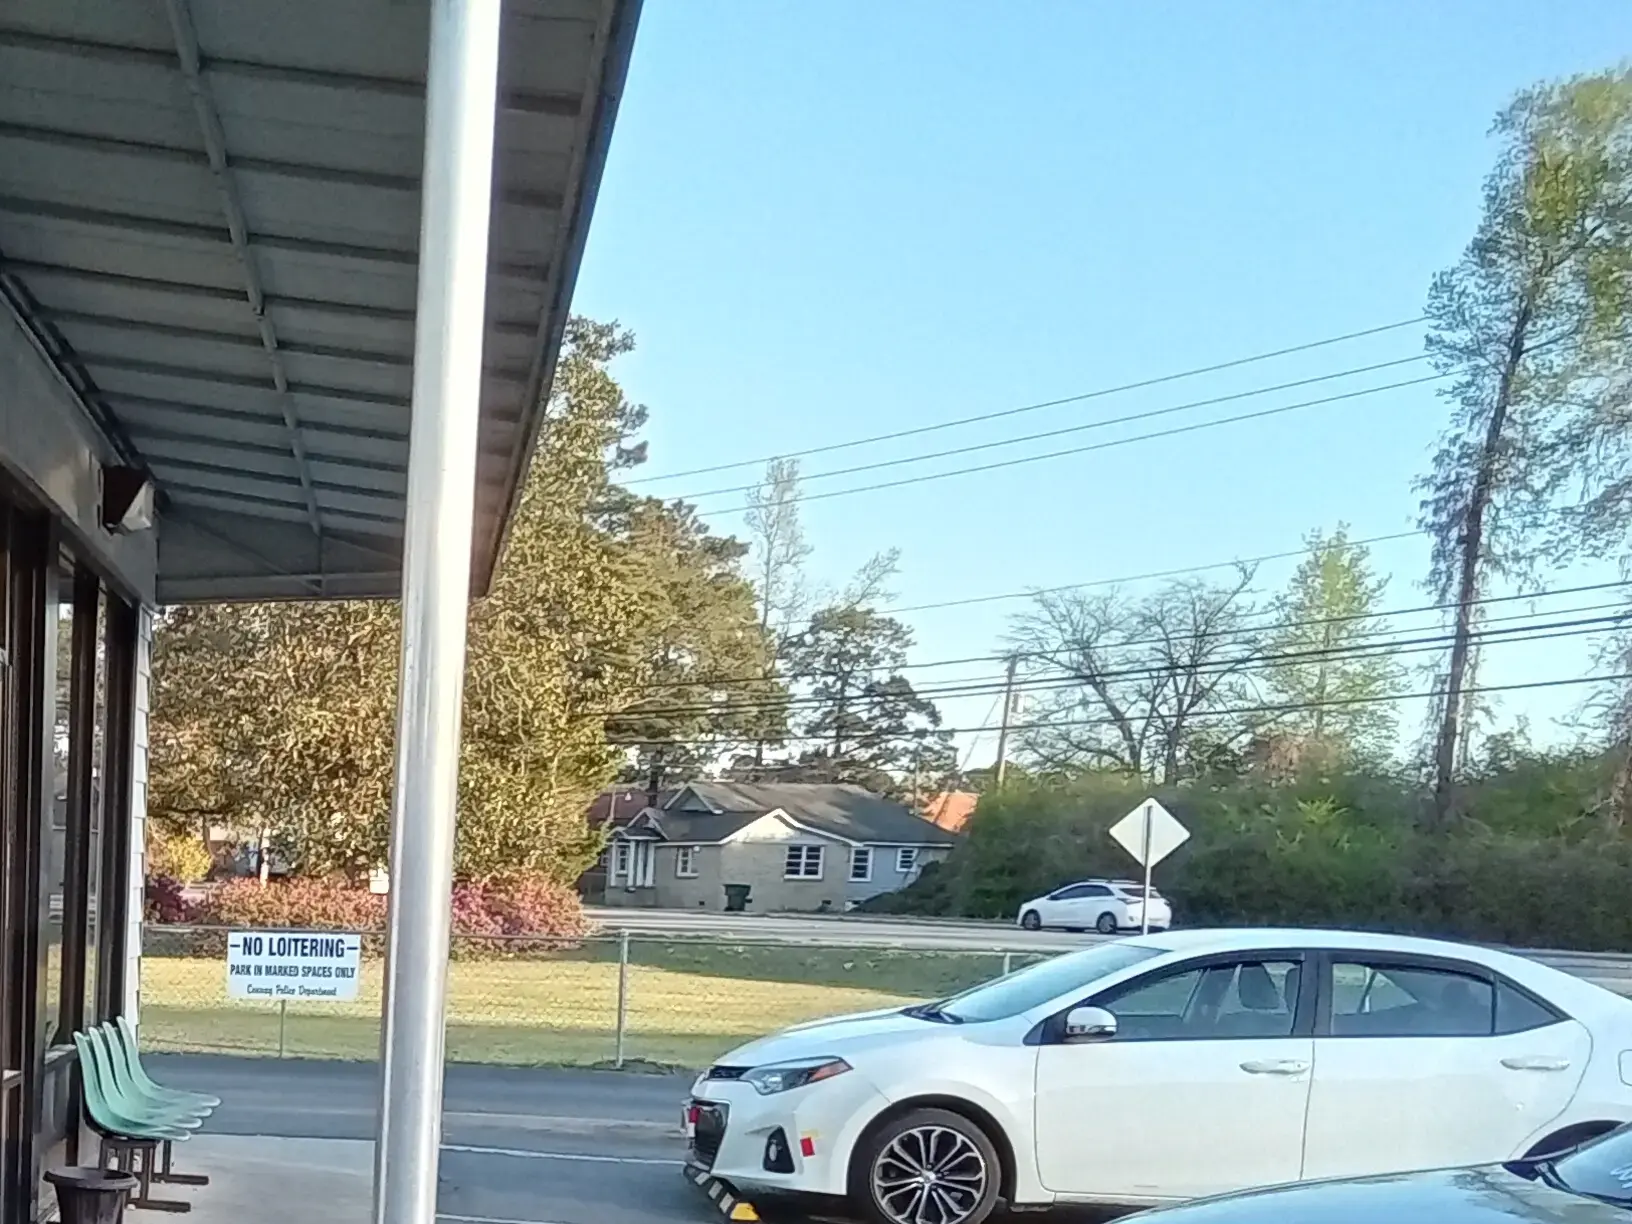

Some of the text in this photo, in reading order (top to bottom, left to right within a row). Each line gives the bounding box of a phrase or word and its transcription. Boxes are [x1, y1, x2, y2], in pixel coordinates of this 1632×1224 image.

[242, 937, 345, 958] NO LOITERING
[230, 964, 356, 978] PARK IN MARKED SPACES ONLY
[276, 984, 296, 995] Police
